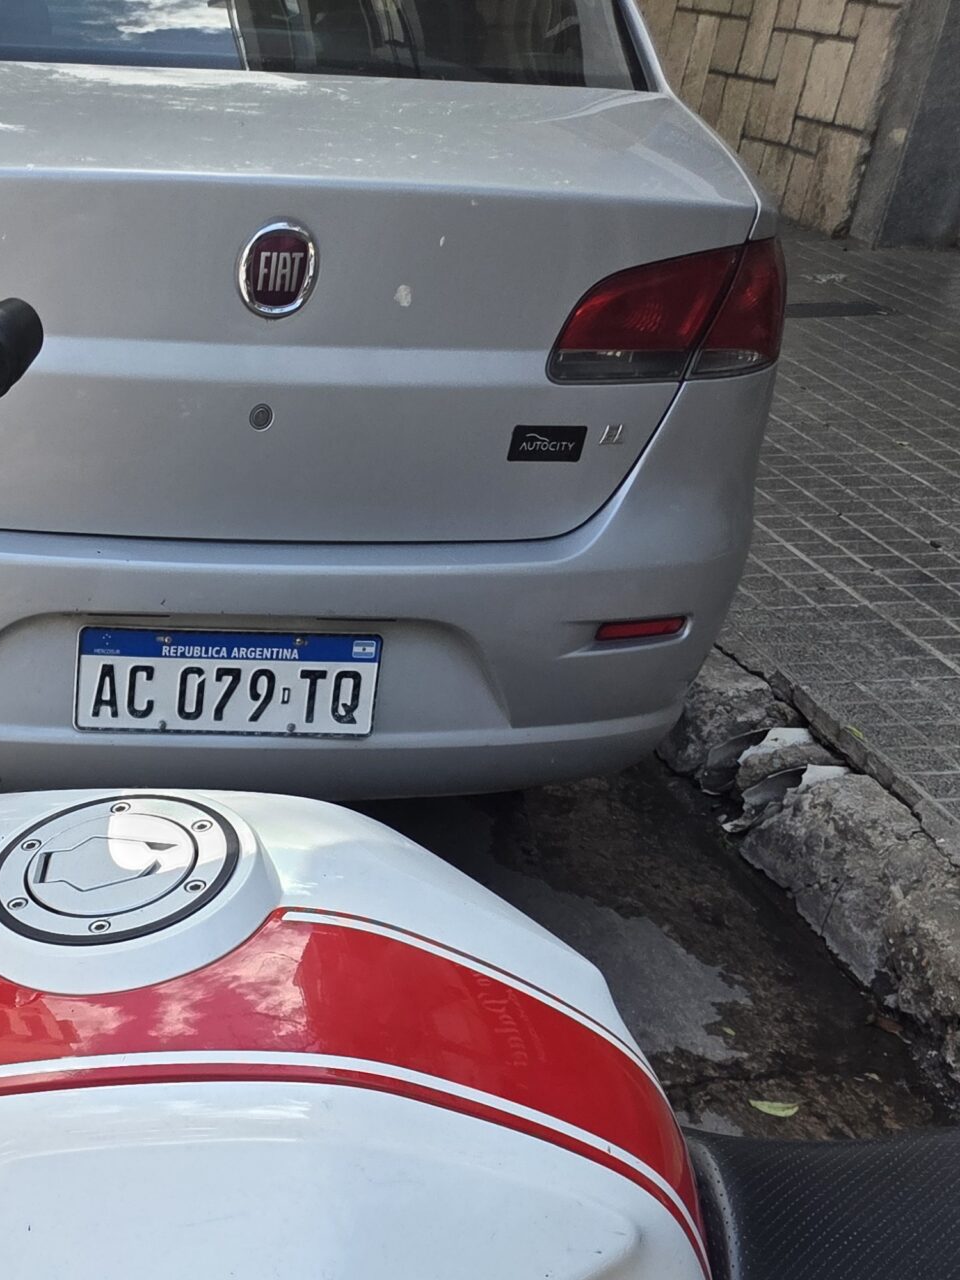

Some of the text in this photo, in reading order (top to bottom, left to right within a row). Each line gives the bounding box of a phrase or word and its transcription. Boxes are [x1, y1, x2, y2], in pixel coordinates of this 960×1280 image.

[257, 252, 304, 292] FIAT
[519, 442, 576, 451] AUTOCITY
[162, 645, 300, 660] REPUBLICA ARGENTINA
[91, 664, 155, 719] AC
[176, 667, 277, 722] 079
[300, 670, 362, 724] TQ
